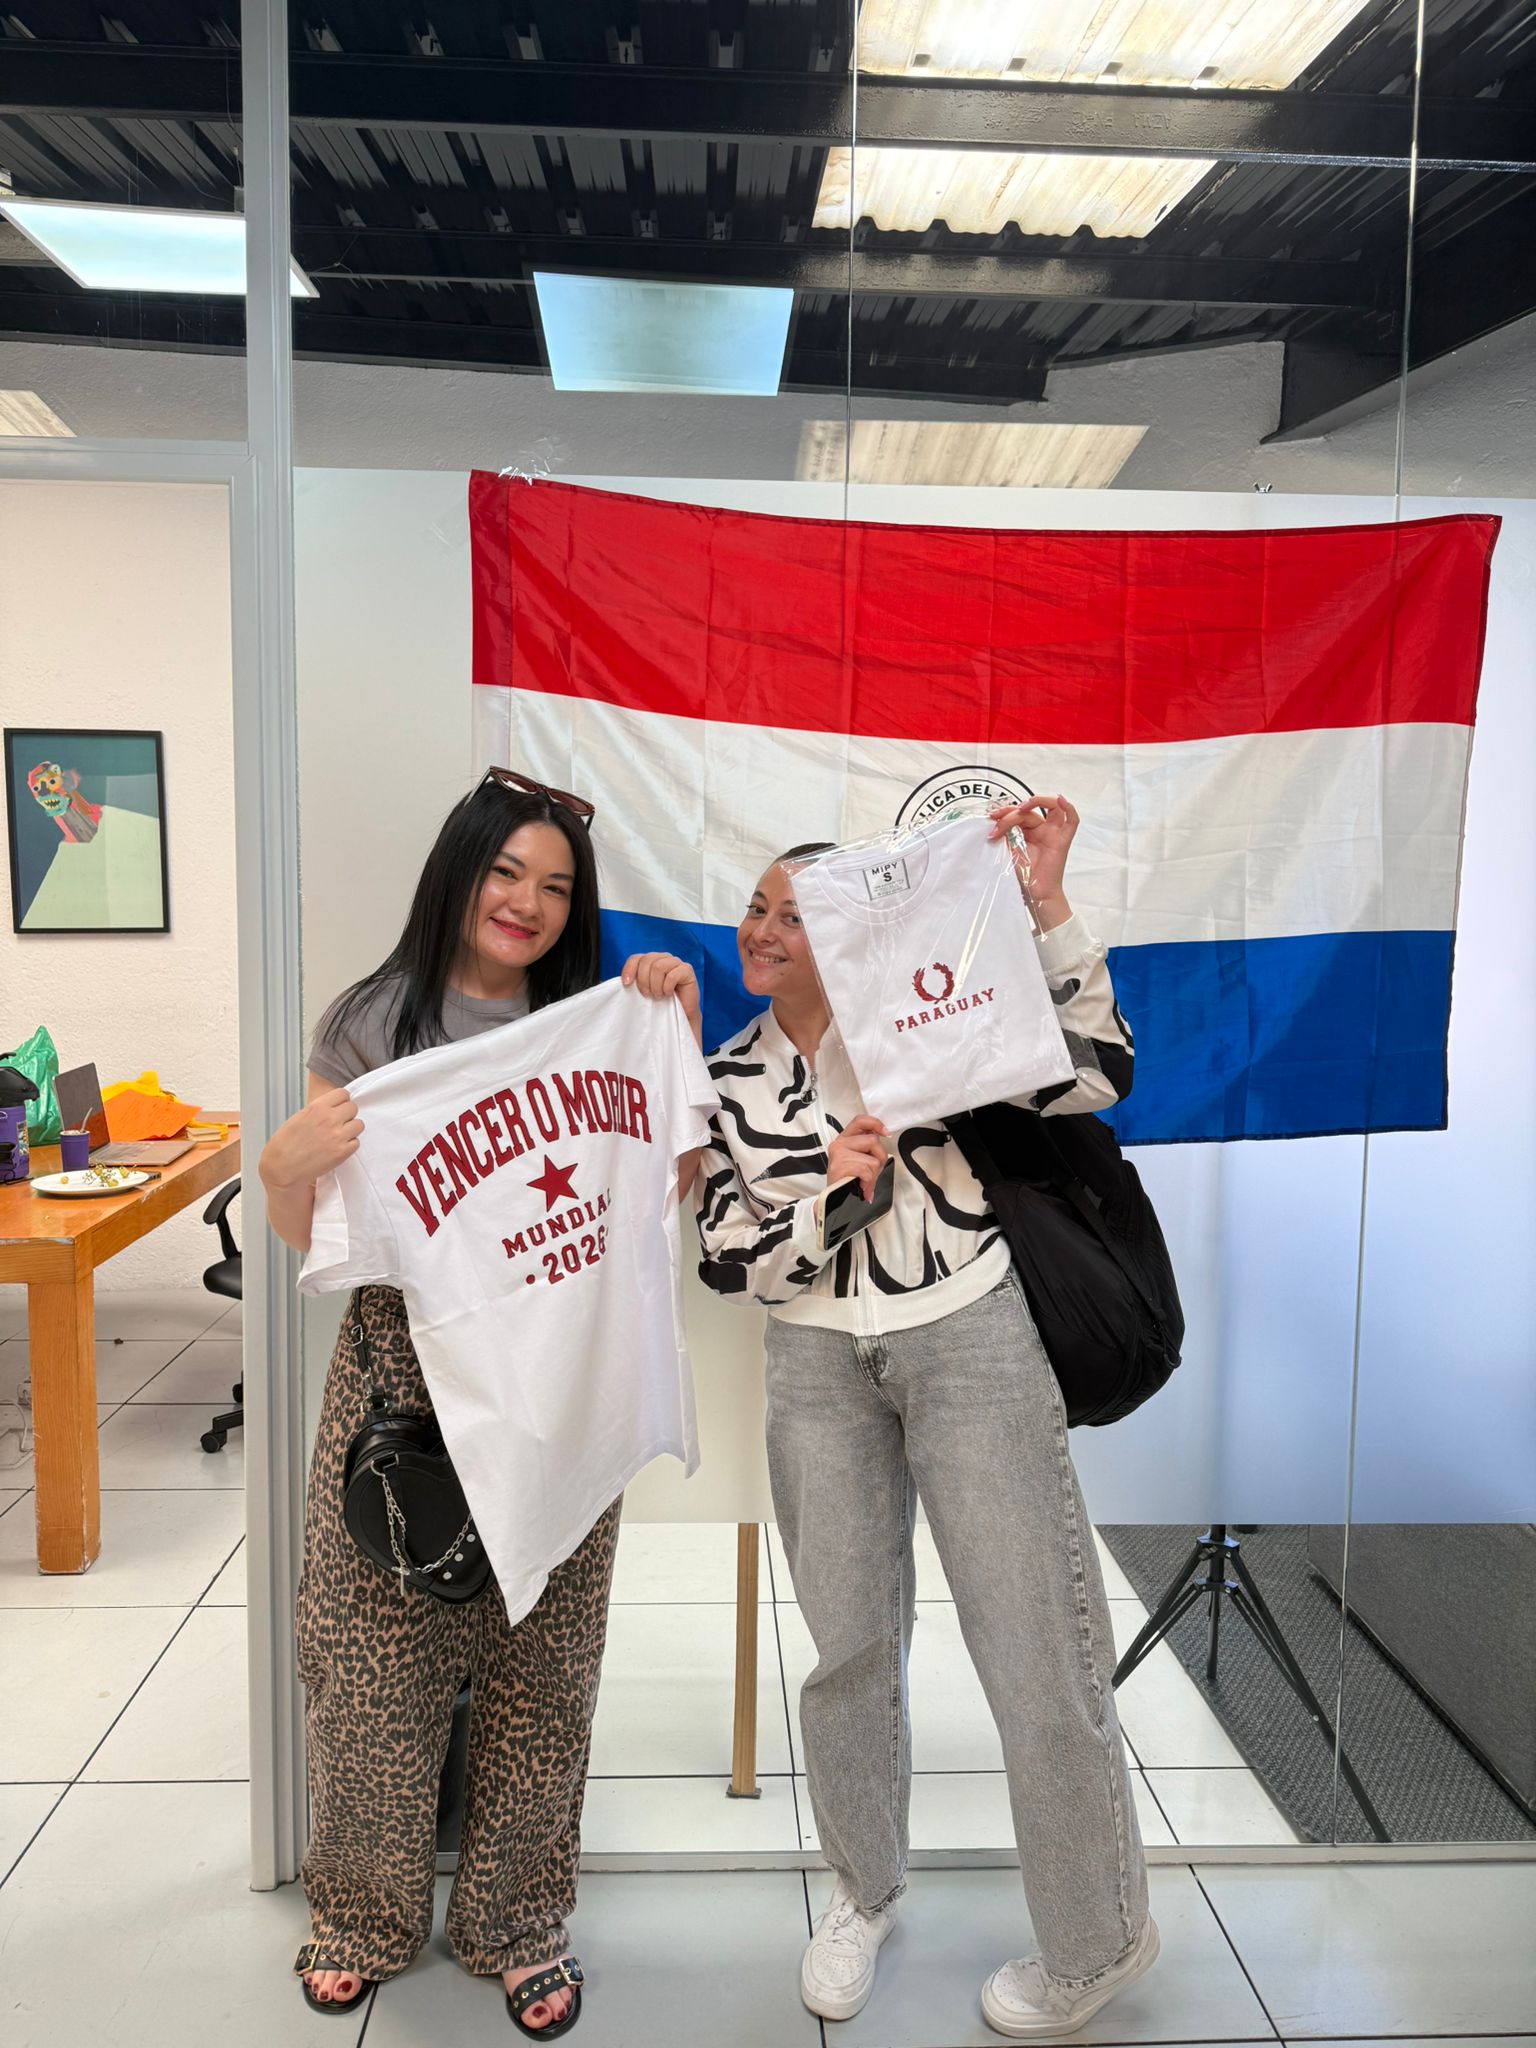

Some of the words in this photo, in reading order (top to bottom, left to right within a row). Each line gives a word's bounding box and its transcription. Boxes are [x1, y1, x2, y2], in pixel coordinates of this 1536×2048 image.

[918, 789, 955, 818] LICA
[960, 783, 992, 797] DEL
[871, 861, 898, 876] MIPY
[883, 871, 893, 882] S
[894, 987, 994, 1033] PARAGUAY
[395, 1087, 536, 1238] VENCER
[526, 1077, 560, 1143] O
